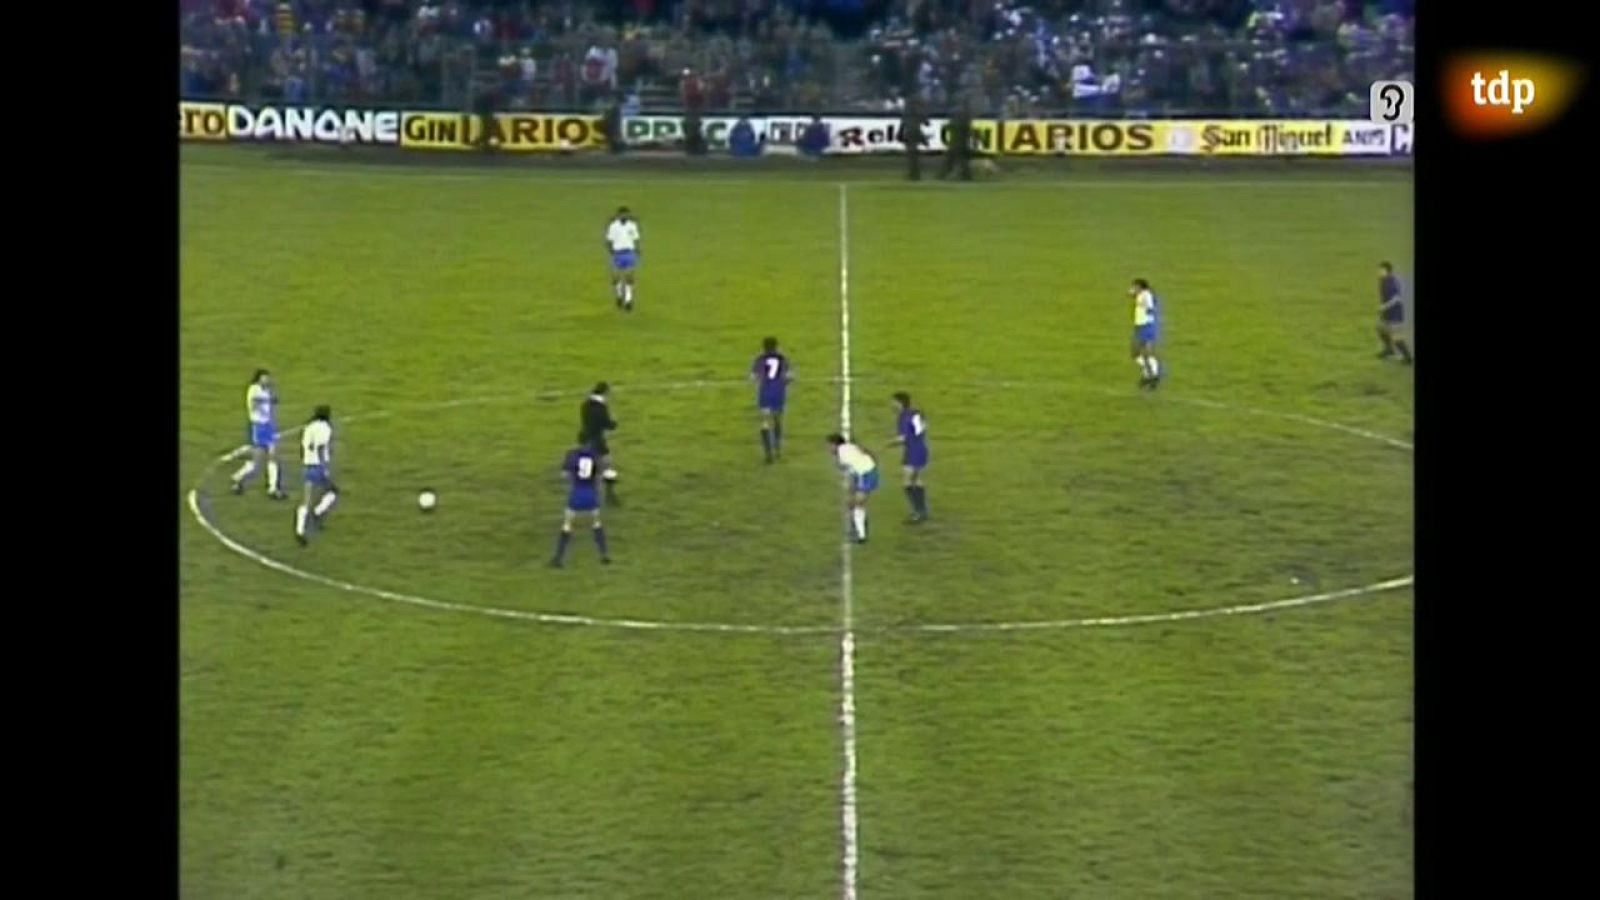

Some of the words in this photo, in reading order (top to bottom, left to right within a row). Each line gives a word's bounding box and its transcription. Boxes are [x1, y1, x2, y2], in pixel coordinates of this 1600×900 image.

[228, 105, 398, 142] DANONE
[404, 115, 456, 143] GIN
[1202, 124, 1251, 150] San
[766, 357, 780, 379] 7
[578, 456, 593, 479] 9
